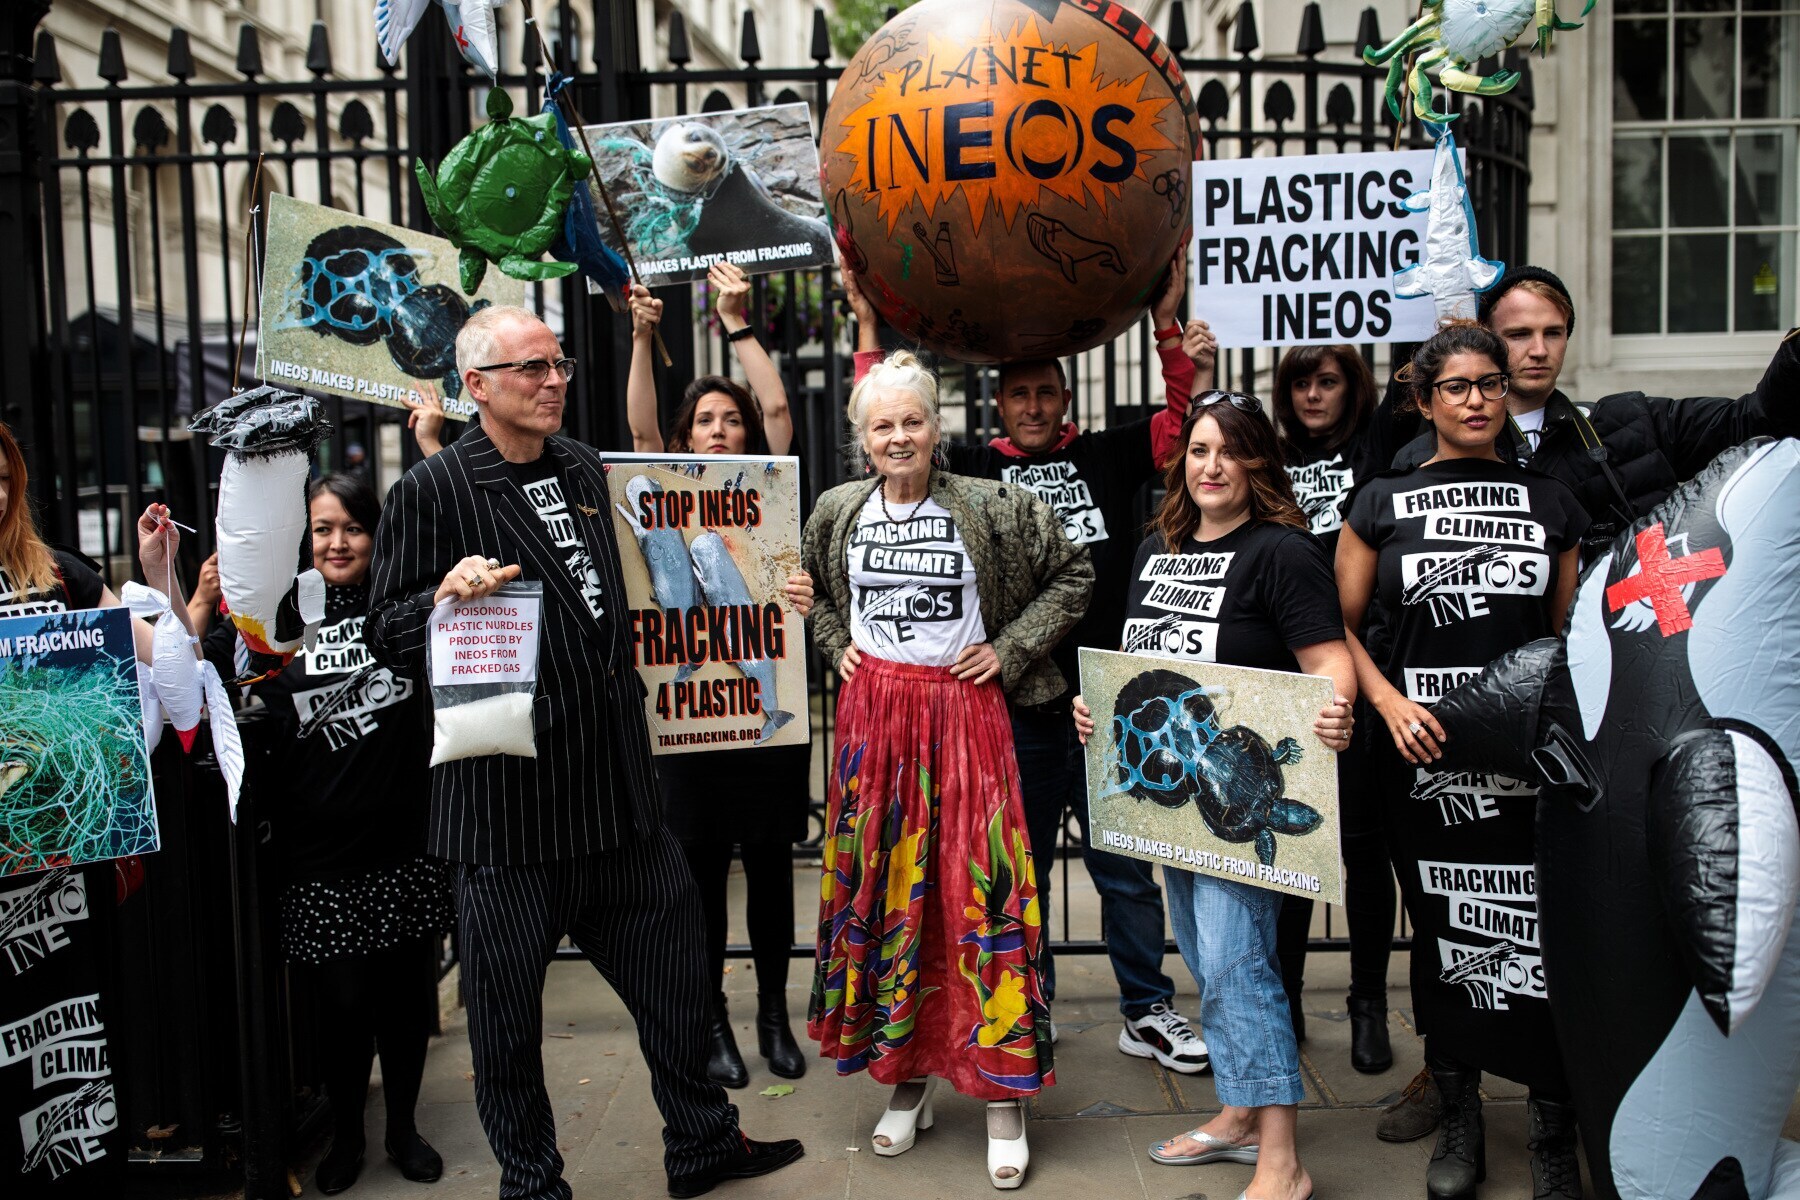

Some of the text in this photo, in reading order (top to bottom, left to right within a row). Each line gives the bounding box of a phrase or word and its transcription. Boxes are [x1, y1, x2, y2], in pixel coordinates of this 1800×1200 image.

[899, 45, 1082, 97] PLANET
[867, 99, 1137, 193] INEOS
[1205, 168, 1414, 227] PLASTICS
[640, 258, 680, 275] MAKES
[681, 253, 725, 270] PLASTIC
[726, 249, 758, 265] FROM
[758, 242, 813, 260] FRACKING
[1198, 229, 1420, 285] FRACKING
[1262, 289, 1393, 341] INEOS
[270, 359, 310, 382] INEOS
[311, 370, 355, 391] MAKES
[357, 379, 407, 401] PLASTIC
[638, 487, 763, 531] STOP INEOS
[1404, 486, 1521, 514] FRACKING
[855, 518, 948, 545] FRACKING
[1435, 516, 1536, 542] CLIMATE
[868, 548, 956, 575] CLIMATE
[1148, 556, 1226, 577] FRACKING
[454, 606, 518, 617] POISONOUS
[1149, 583, 1216, 612] CLIMATE
[438, 621, 534, 633] PLASTIC NURDLES
[449, 635, 523, 646] PRODUCED BY
[628, 602, 787, 668] FRACKING
[15, 628, 105, 656] FRACKING
[454, 649, 518, 660] INEOS FROM
[451, 663, 521, 675] FRACKED GAS
[655, 676, 763, 721] 4 PLASTIC
[657, 728, 762, 747] TALKFRACKING.ORG
[1102, 829, 1321, 892] INEOS MAKES PLASTIC FROM FRACKING
[1428, 866, 1536, 895] FRACKING
[1458, 902, 1538, 942] CLIMAT
[0, 999, 103, 1058] FRACKIN
